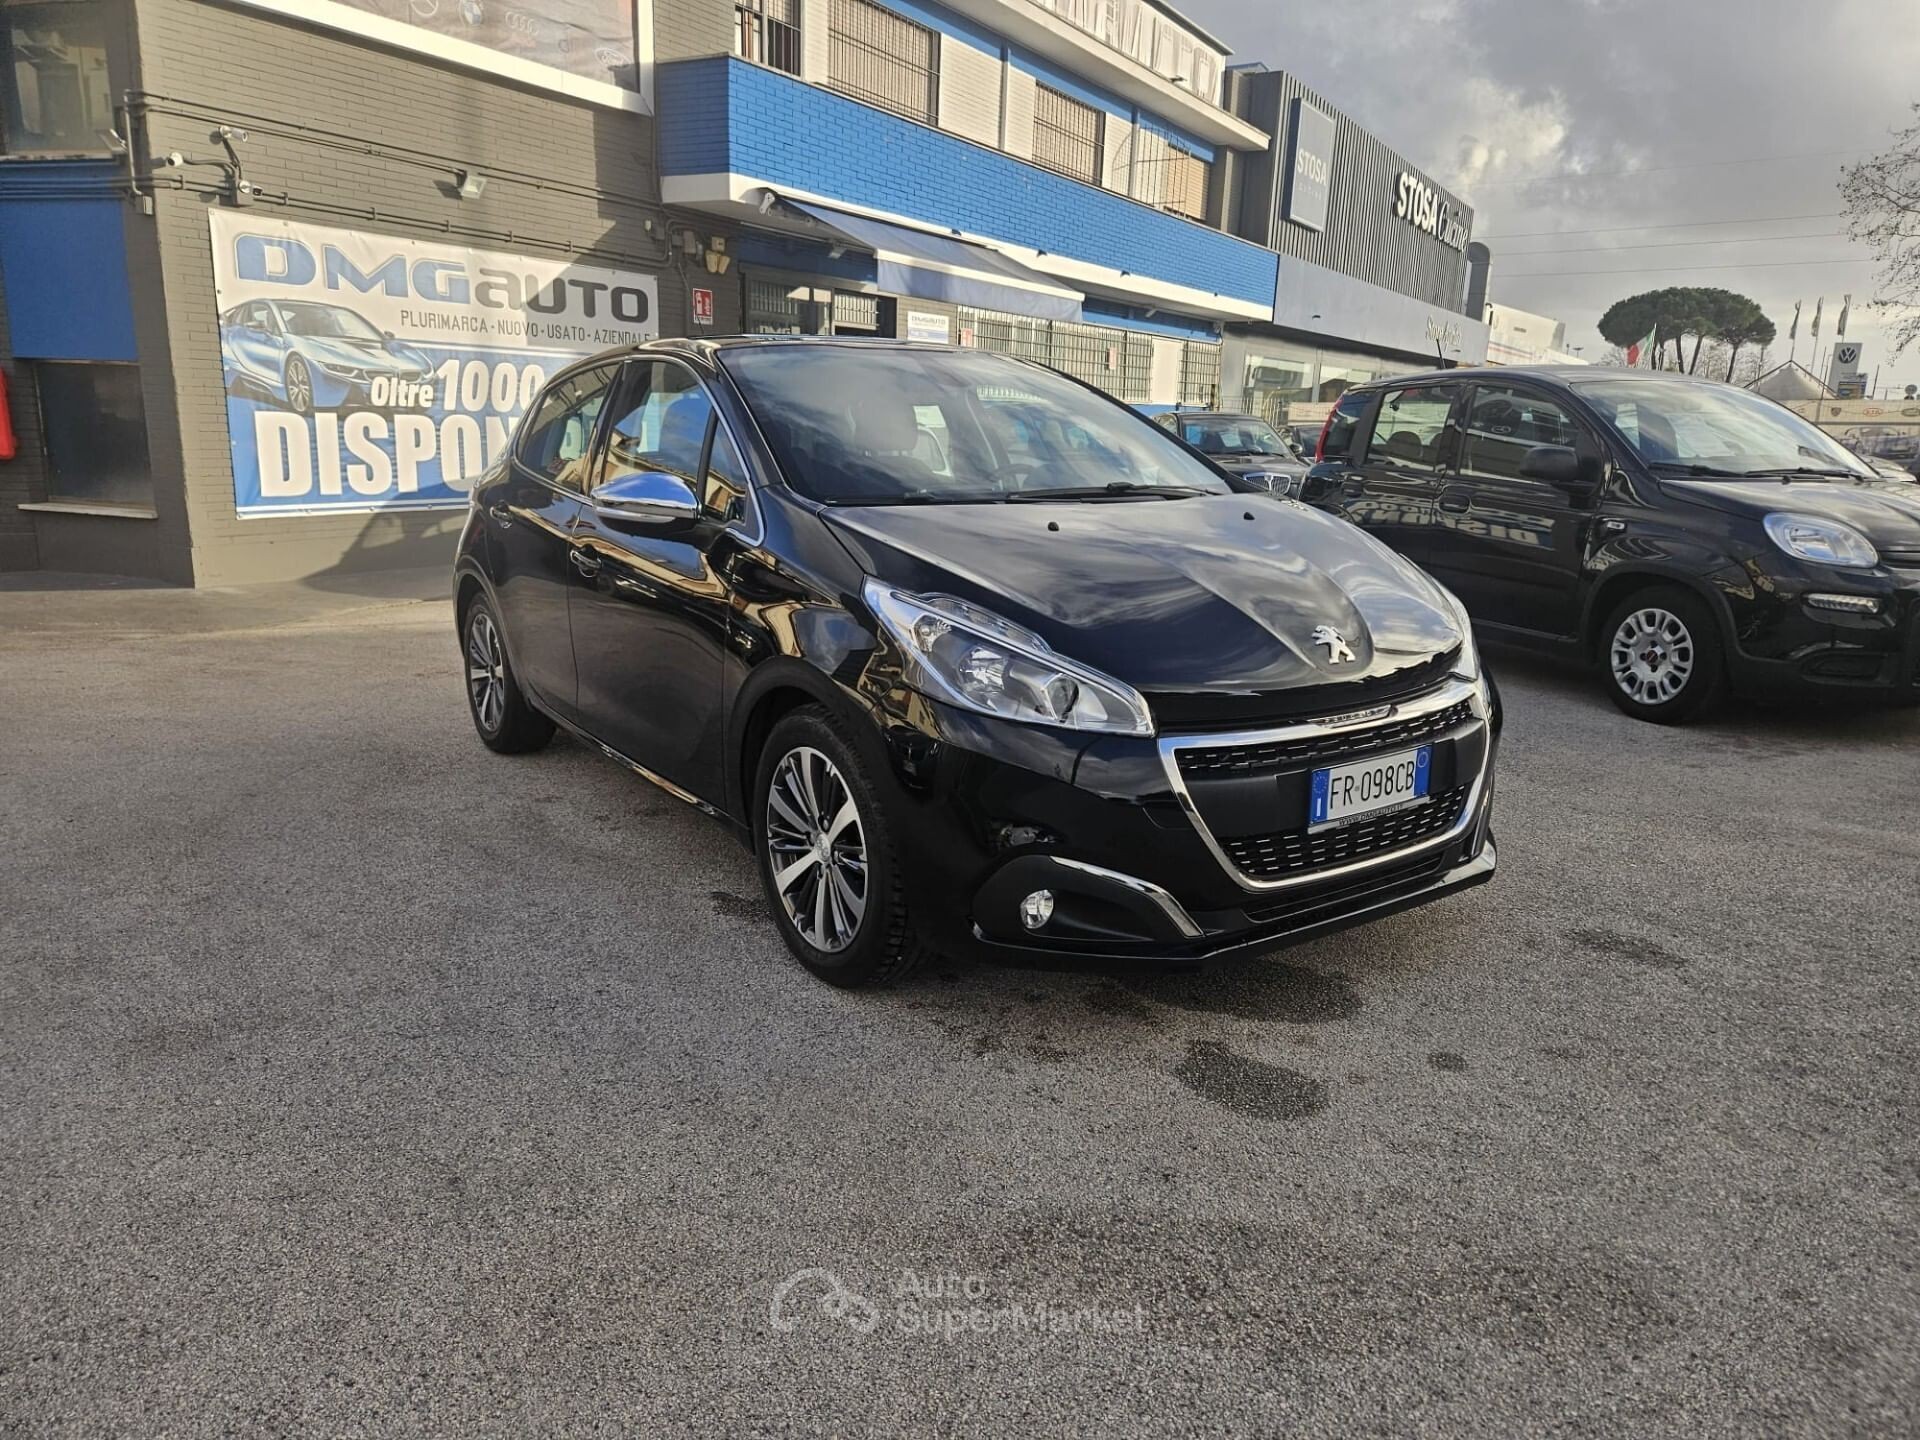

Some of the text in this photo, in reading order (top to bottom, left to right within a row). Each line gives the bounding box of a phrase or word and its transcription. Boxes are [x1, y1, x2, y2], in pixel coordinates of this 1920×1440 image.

[1297, 149, 1328, 186] STOSA
[1397, 171, 1438, 236] STOSA
[400, 310, 488, 333] PLURIMARCA
[498, 320, 538, 337] NUOVO
[547, 325, 585, 341] USATO
[371, 359, 545, 413] Oltre 1000
